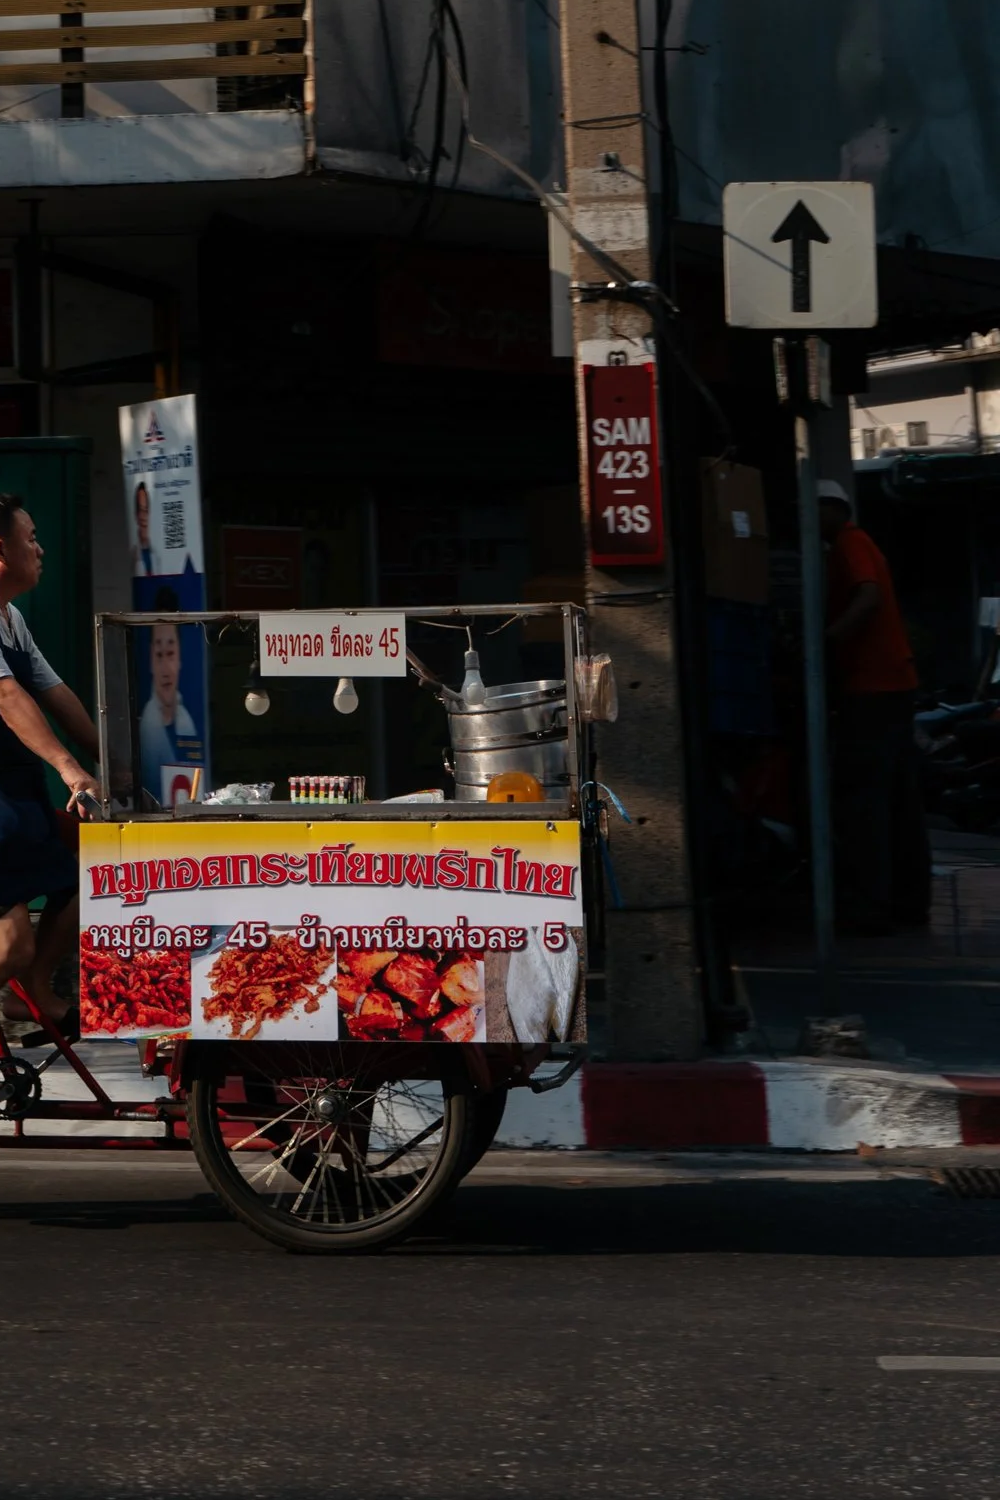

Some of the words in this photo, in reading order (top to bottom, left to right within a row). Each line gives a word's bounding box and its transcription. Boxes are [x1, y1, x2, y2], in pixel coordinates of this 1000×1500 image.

[592, 417, 651, 446] SAM
[597, 450, 650, 479] 423
[602, 504, 651, 534] 13S
[265, 633, 324, 664] หมูทอด
[330, 625, 373, 657] ขีดละ
[378, 627, 399, 658] 45
[87, 843, 578, 906] หมูทอดกระเทียมพริกไทย
[88, 915, 210, 959] หมูขีดละ
[226, 921, 270, 952] 45
[296, 913, 525, 952] ข้าวเหนียวห่อละ
[543, 922, 567, 953] 5
